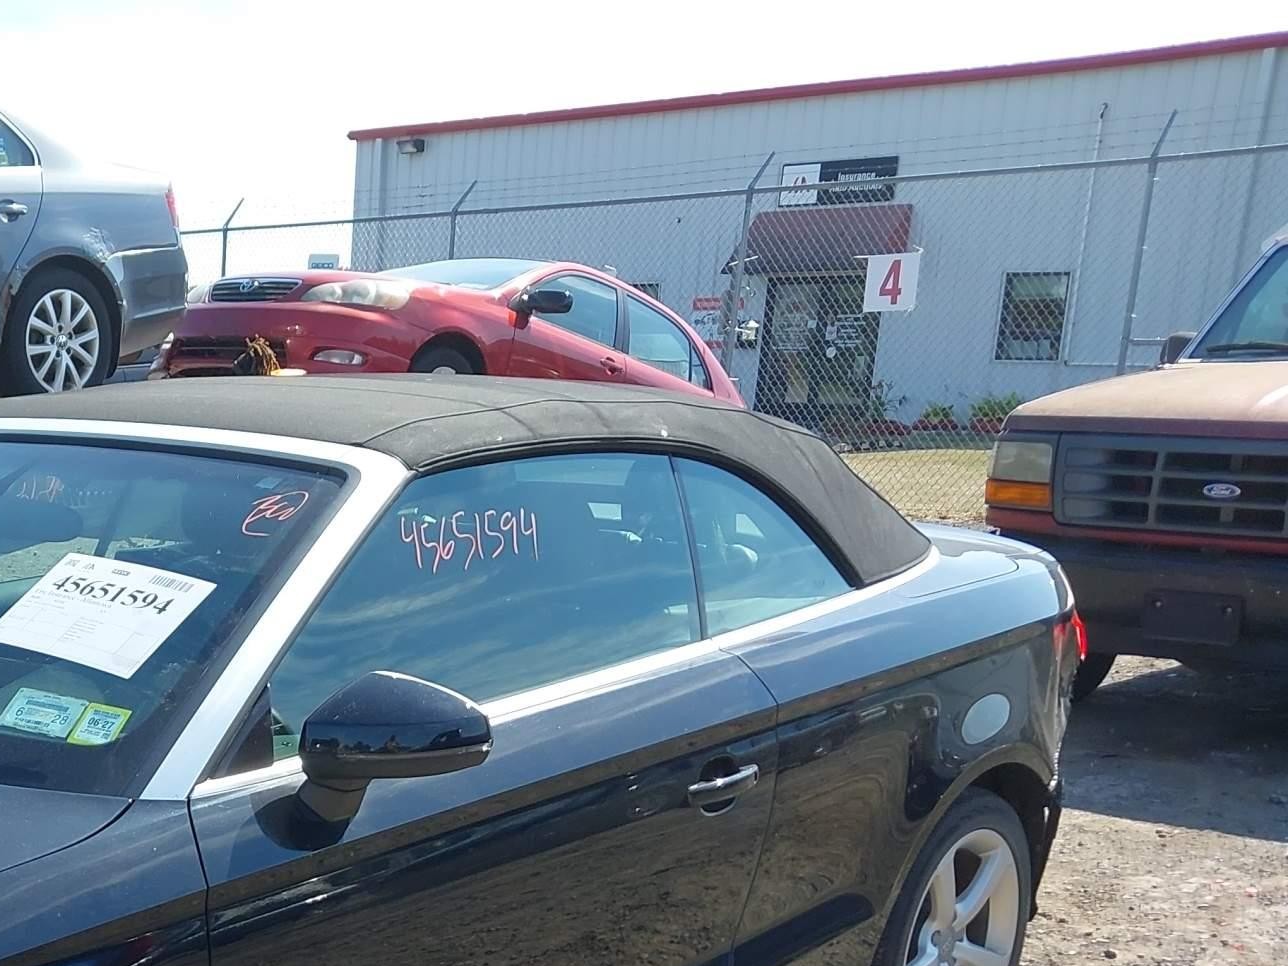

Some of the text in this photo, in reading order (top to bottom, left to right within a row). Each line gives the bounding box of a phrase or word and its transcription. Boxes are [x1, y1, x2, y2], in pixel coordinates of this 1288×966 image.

[879, 259, 902, 305] 4
[401, 507, 539, 575] 45651594
[53, 575, 176, 614] 45651594
[50, 714, 69, 725] 28
